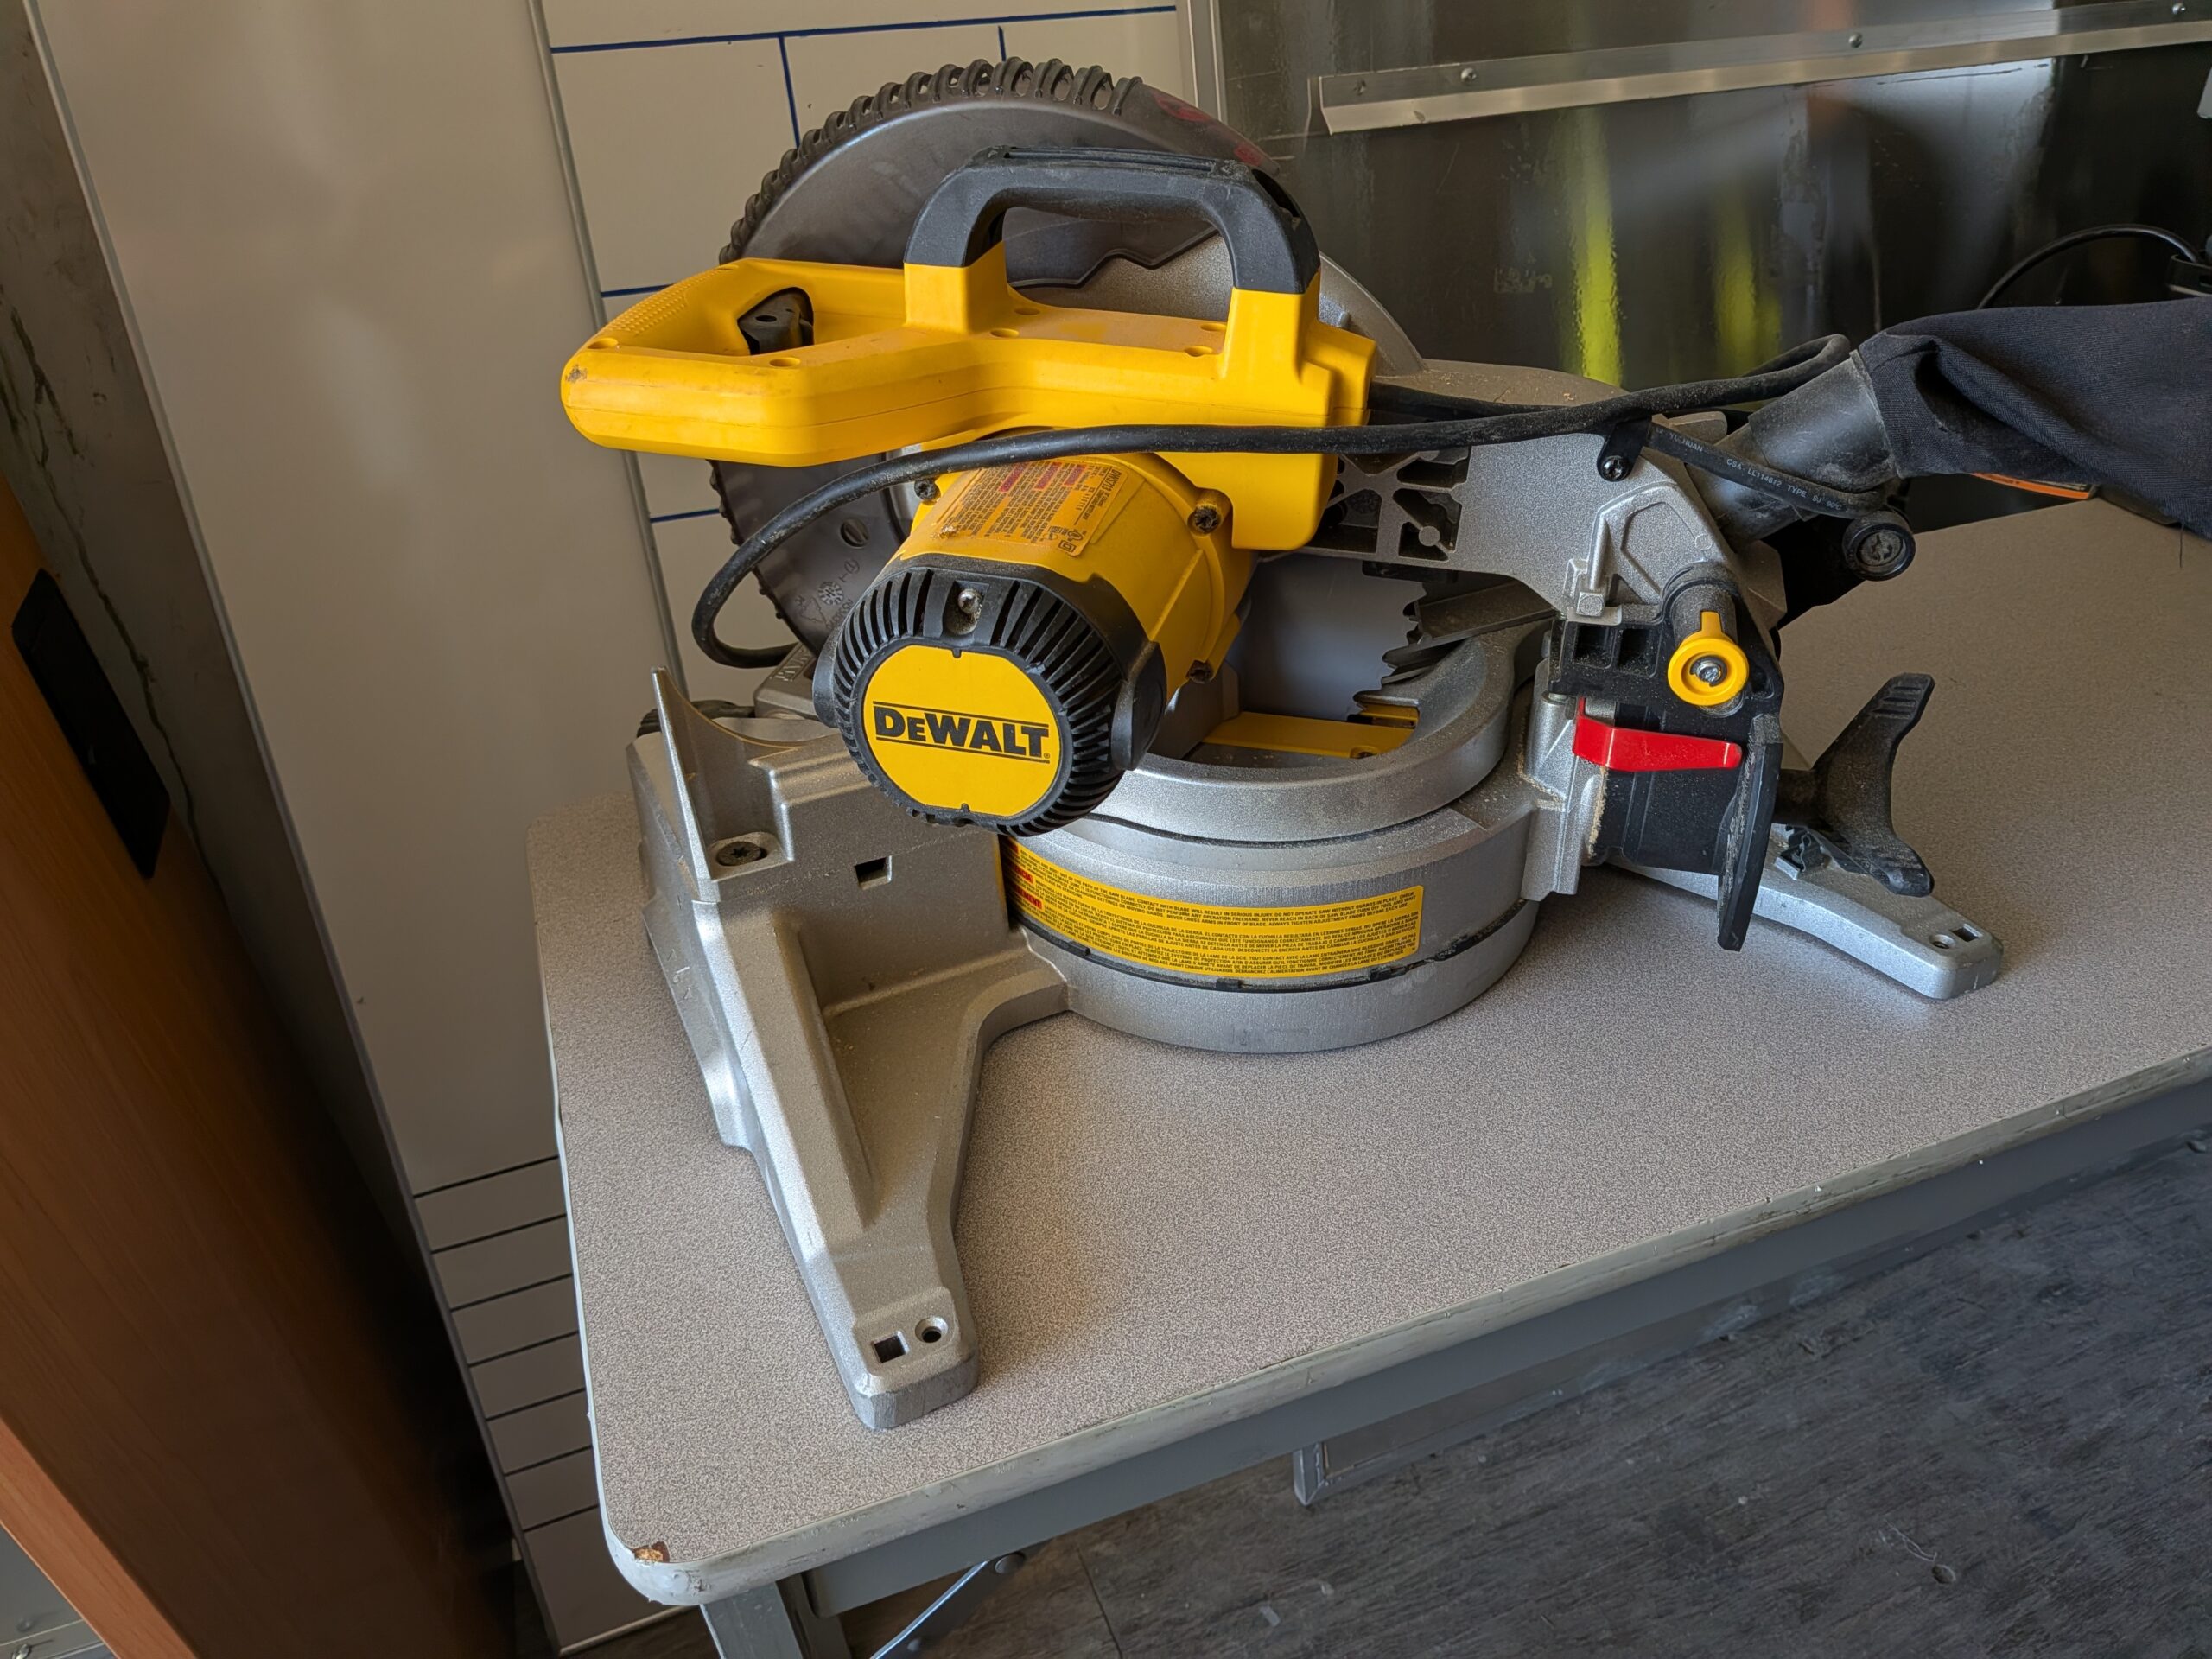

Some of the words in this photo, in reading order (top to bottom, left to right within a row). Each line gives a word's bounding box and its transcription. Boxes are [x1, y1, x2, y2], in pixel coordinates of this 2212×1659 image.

[1101, 469, 1122, 491] DWS713
[1788, 485, 1808, 498] TYPE
[1812, 495, 1822, 504] SJ
[874, 706, 1049, 758] DEWALT
[1137, 899, 1158, 907] CONTACT
